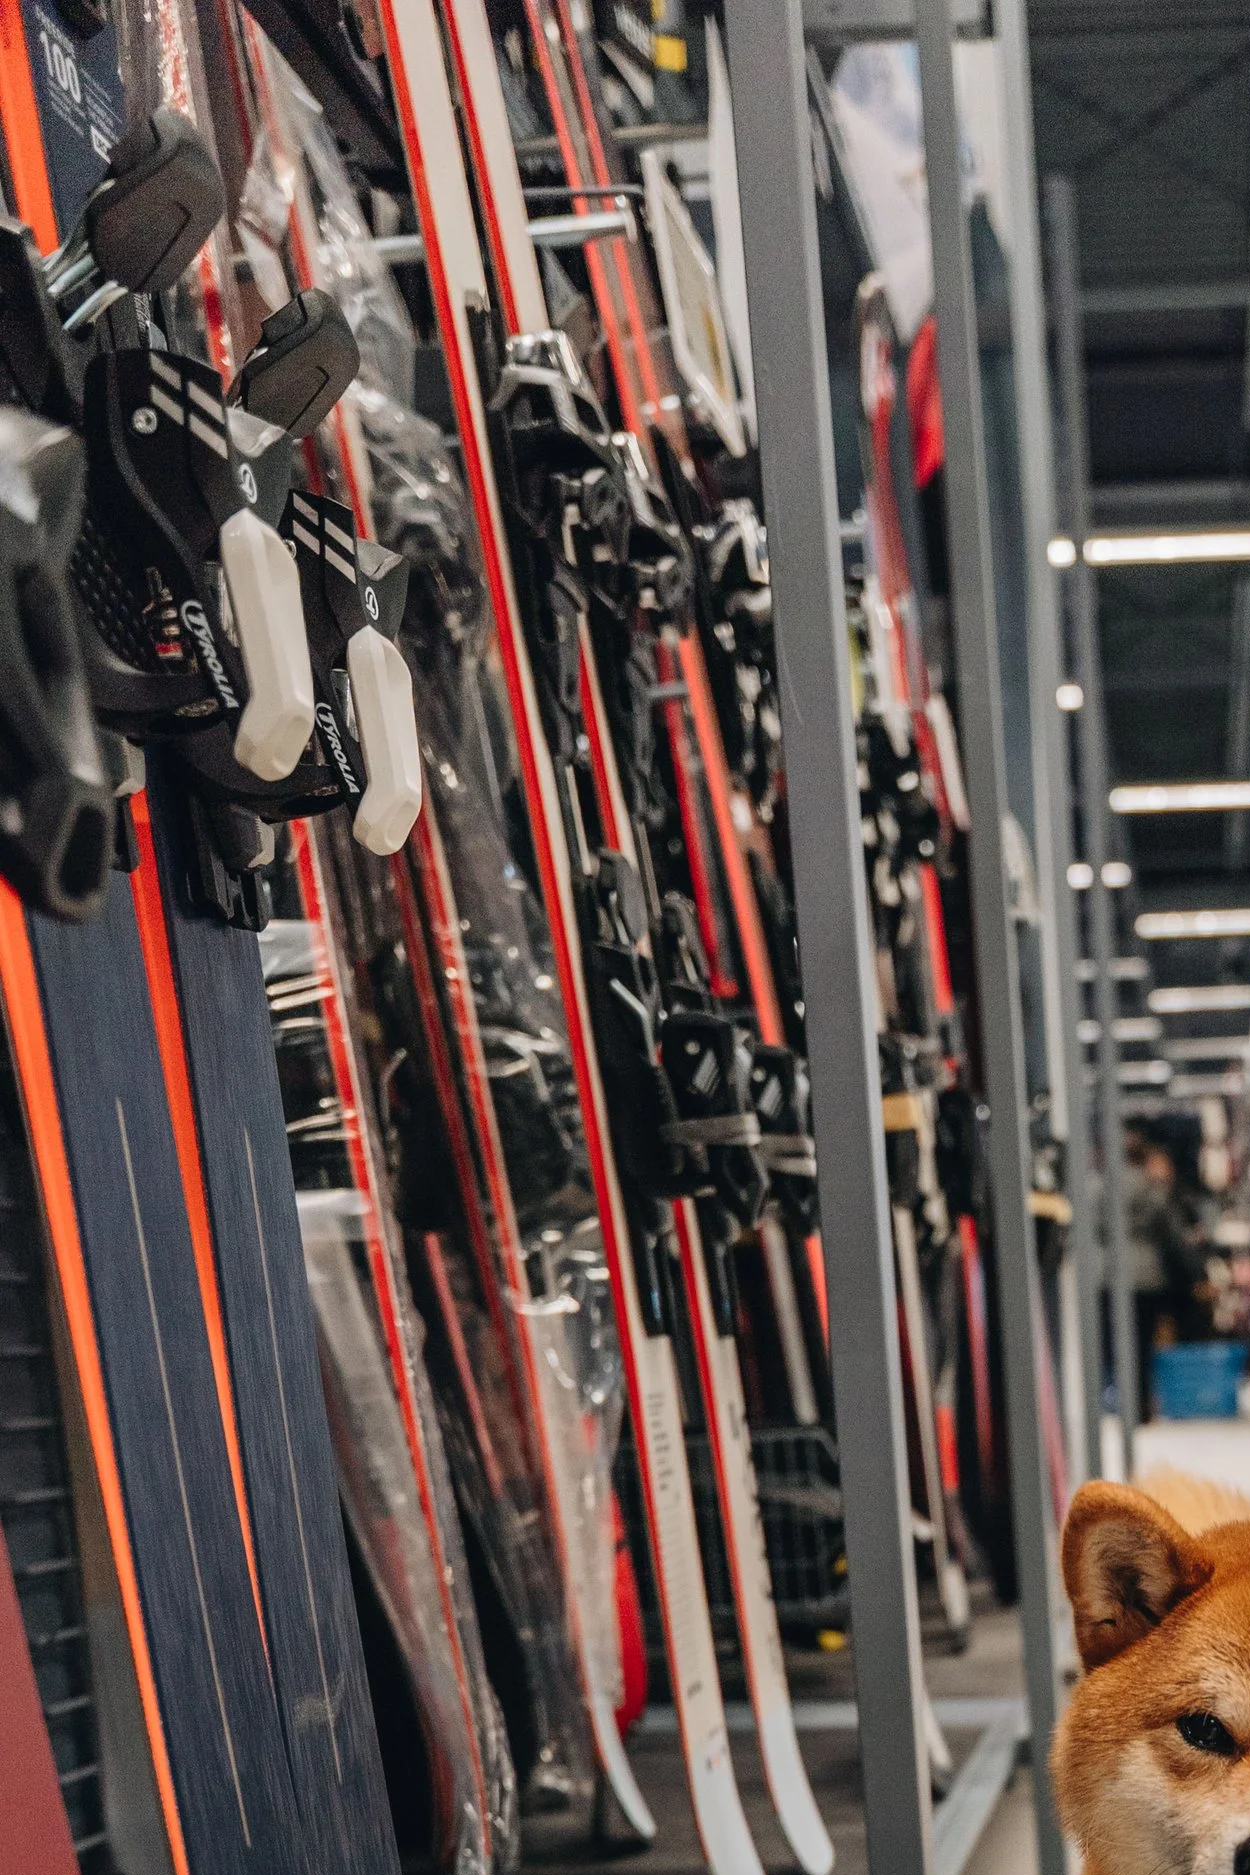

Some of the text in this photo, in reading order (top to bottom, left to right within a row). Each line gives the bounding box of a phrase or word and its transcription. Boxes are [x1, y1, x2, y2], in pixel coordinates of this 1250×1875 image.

[39, 30, 82, 104] 100
[181, 600, 240, 708] TYROLIA
[315, 702, 360, 793] TYROLIA
